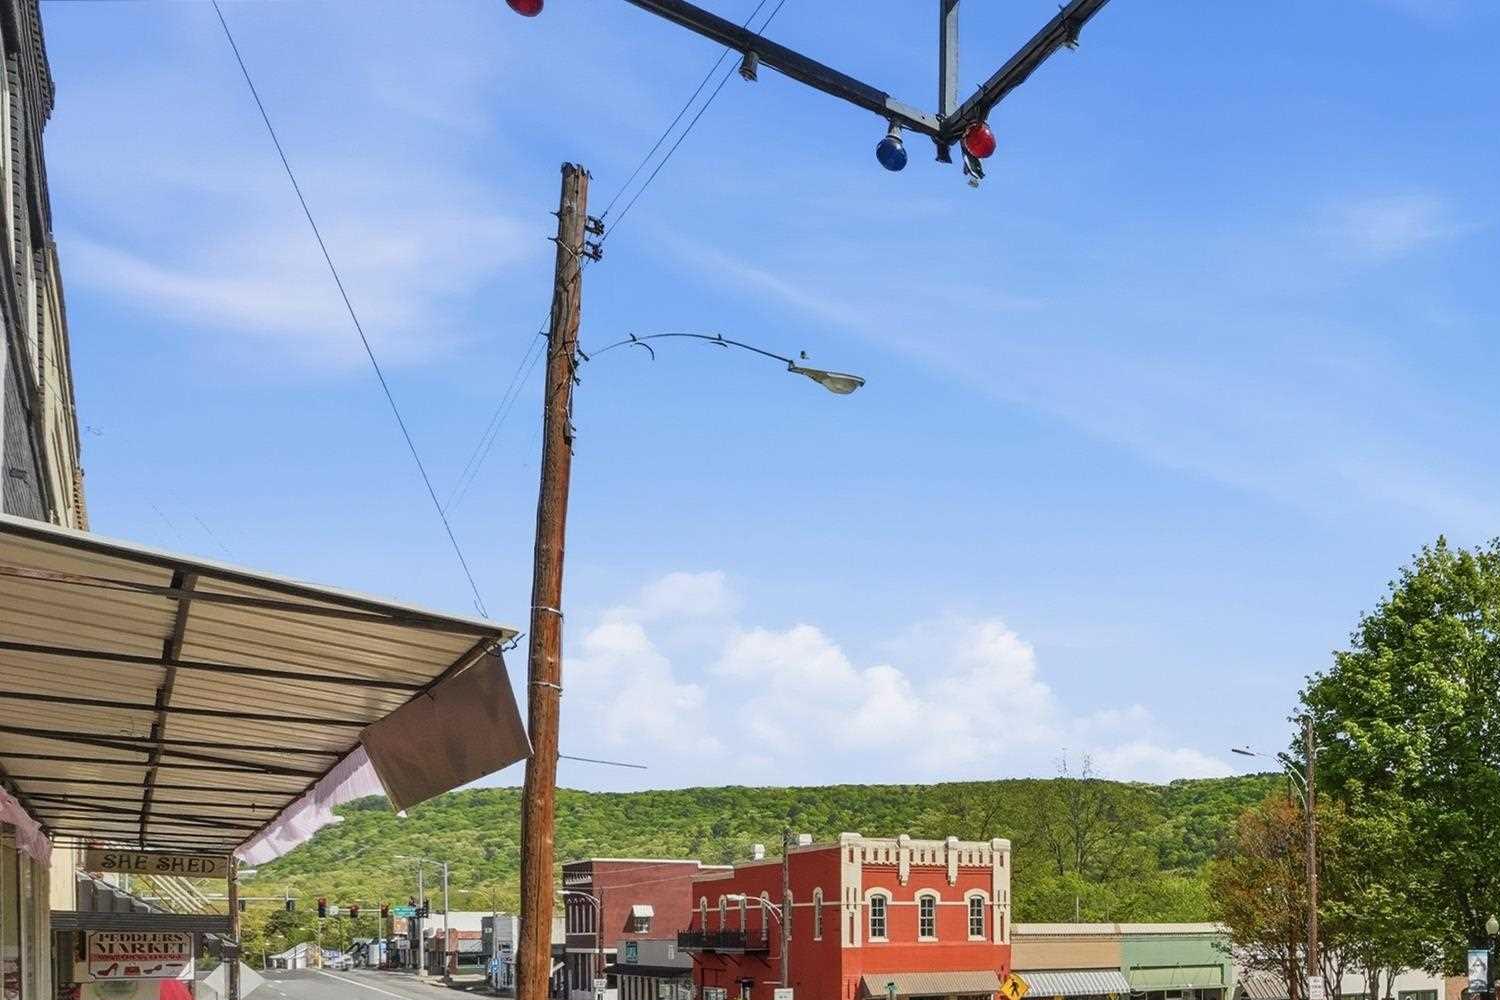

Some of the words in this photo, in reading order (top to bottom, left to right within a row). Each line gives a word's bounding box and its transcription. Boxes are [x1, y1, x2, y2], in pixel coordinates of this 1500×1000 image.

[101, 853, 148, 870] SHE
[156, 856, 216, 873] SHED
[98, 933, 183, 942] PEDDLERS
[96, 942, 188, 954] MARKET
